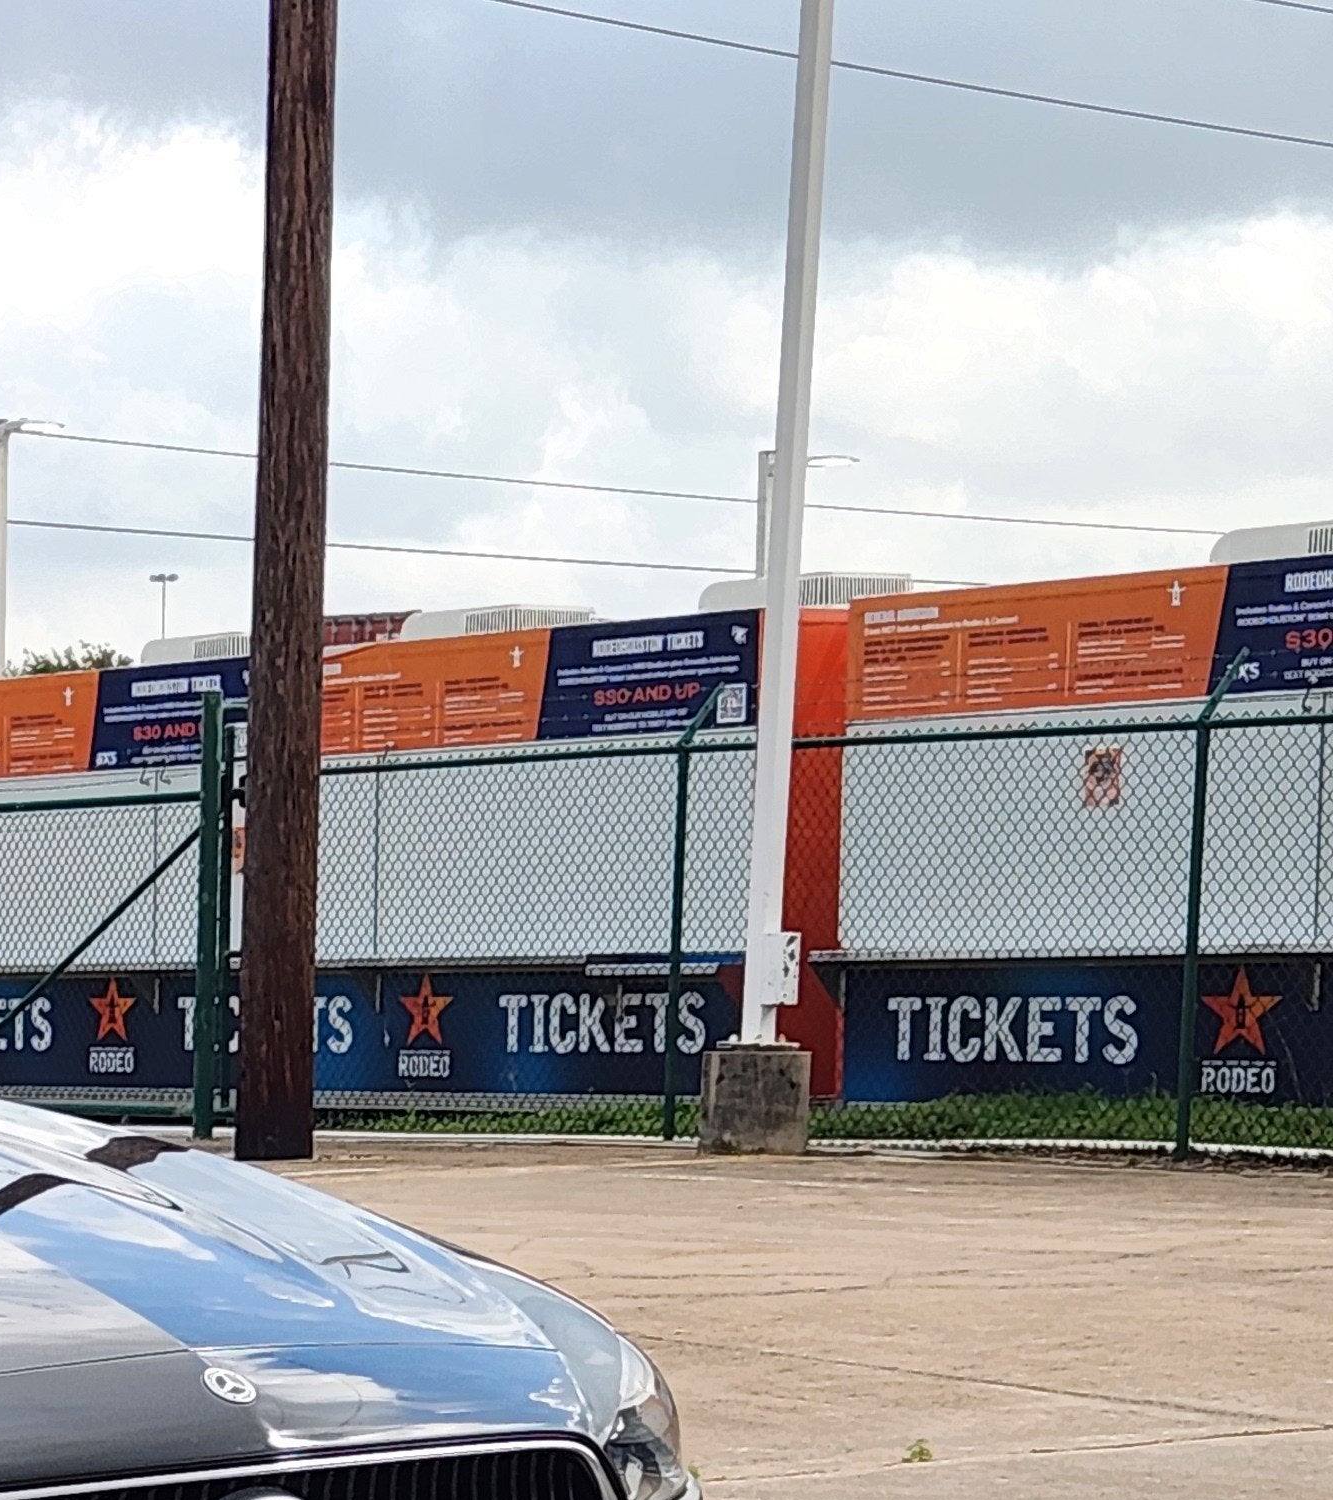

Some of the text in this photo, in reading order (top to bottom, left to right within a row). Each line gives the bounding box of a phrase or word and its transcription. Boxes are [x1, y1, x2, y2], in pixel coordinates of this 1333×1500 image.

[632, 684, 671, 703] AND
[674, 681, 701, 700] UP
[163, 722, 196, 739] AND
[499, 992, 705, 1054] TICKETS
[887, 995, 1139, 1065] TICKETS
[89, 1051, 135, 1074] RODEO
[397, 1054, 451, 1078] RODEO
[1200, 1066, 1276, 1094] RODEO
